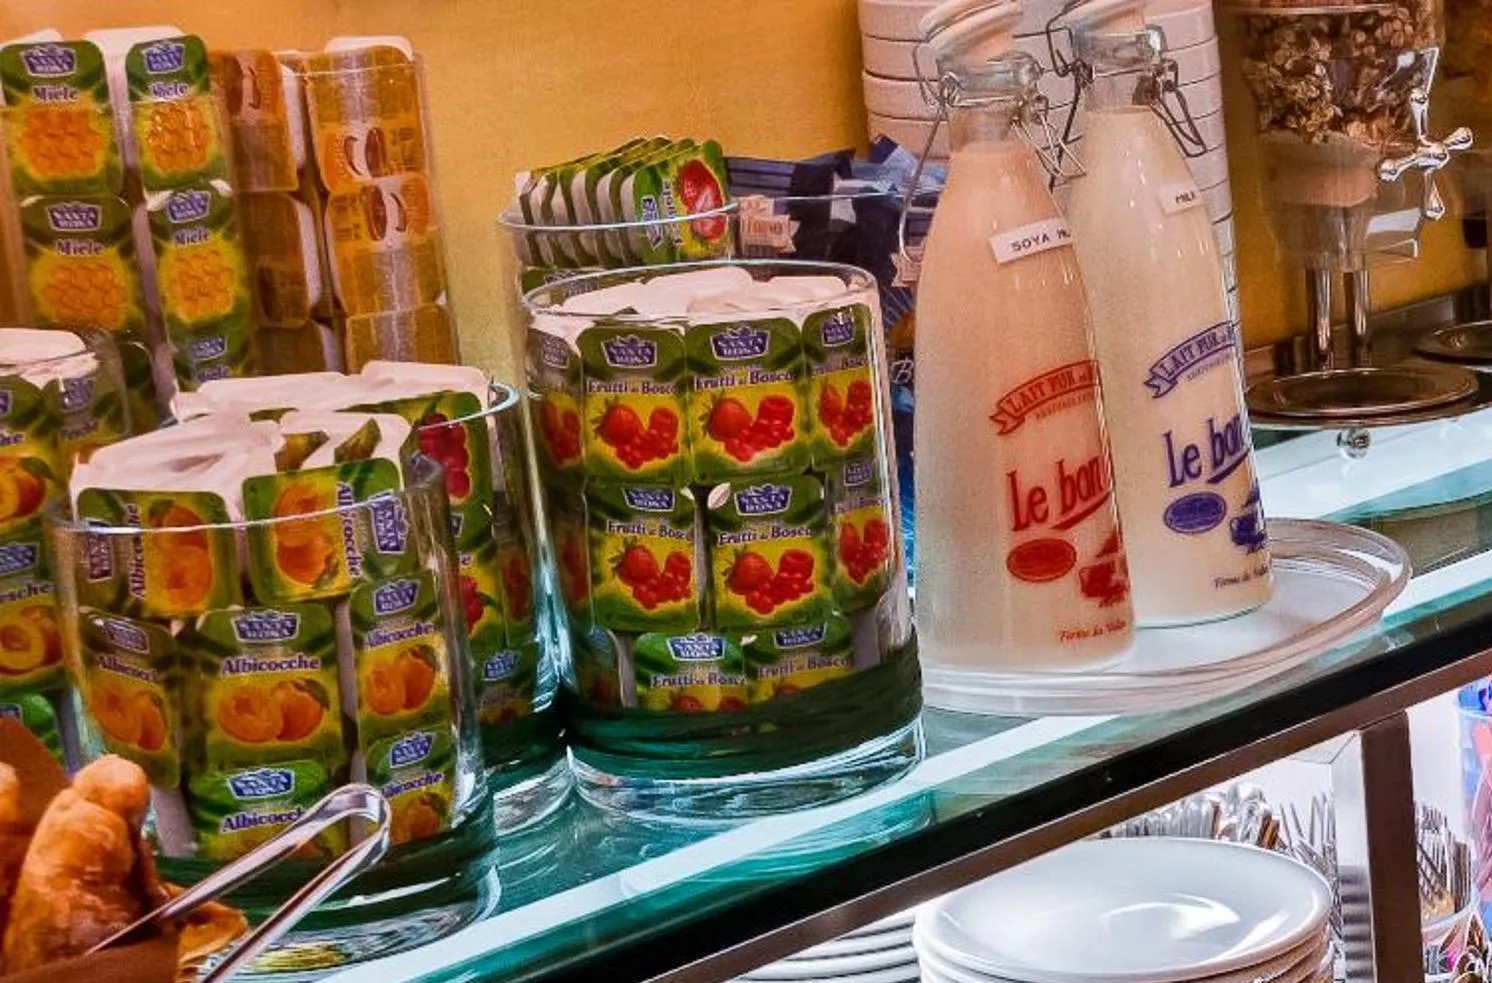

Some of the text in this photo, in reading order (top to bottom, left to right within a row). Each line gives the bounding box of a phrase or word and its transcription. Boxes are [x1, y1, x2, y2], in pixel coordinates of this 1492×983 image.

[33, 85, 78, 101] Miele
[56, 239, 104, 255] Miele
[1011, 233, 1050, 251] SOYA
[1159, 344, 1196, 378] LAIT
[749, 370, 796, 384] Bosco
[1006, 381, 1047, 413] LAIT
[1162, 430, 1202, 487] Le
[1006, 471, 1049, 531] Le
[222, 654, 321, 674] Albicocche
[222, 807, 306, 832] Albicocc
